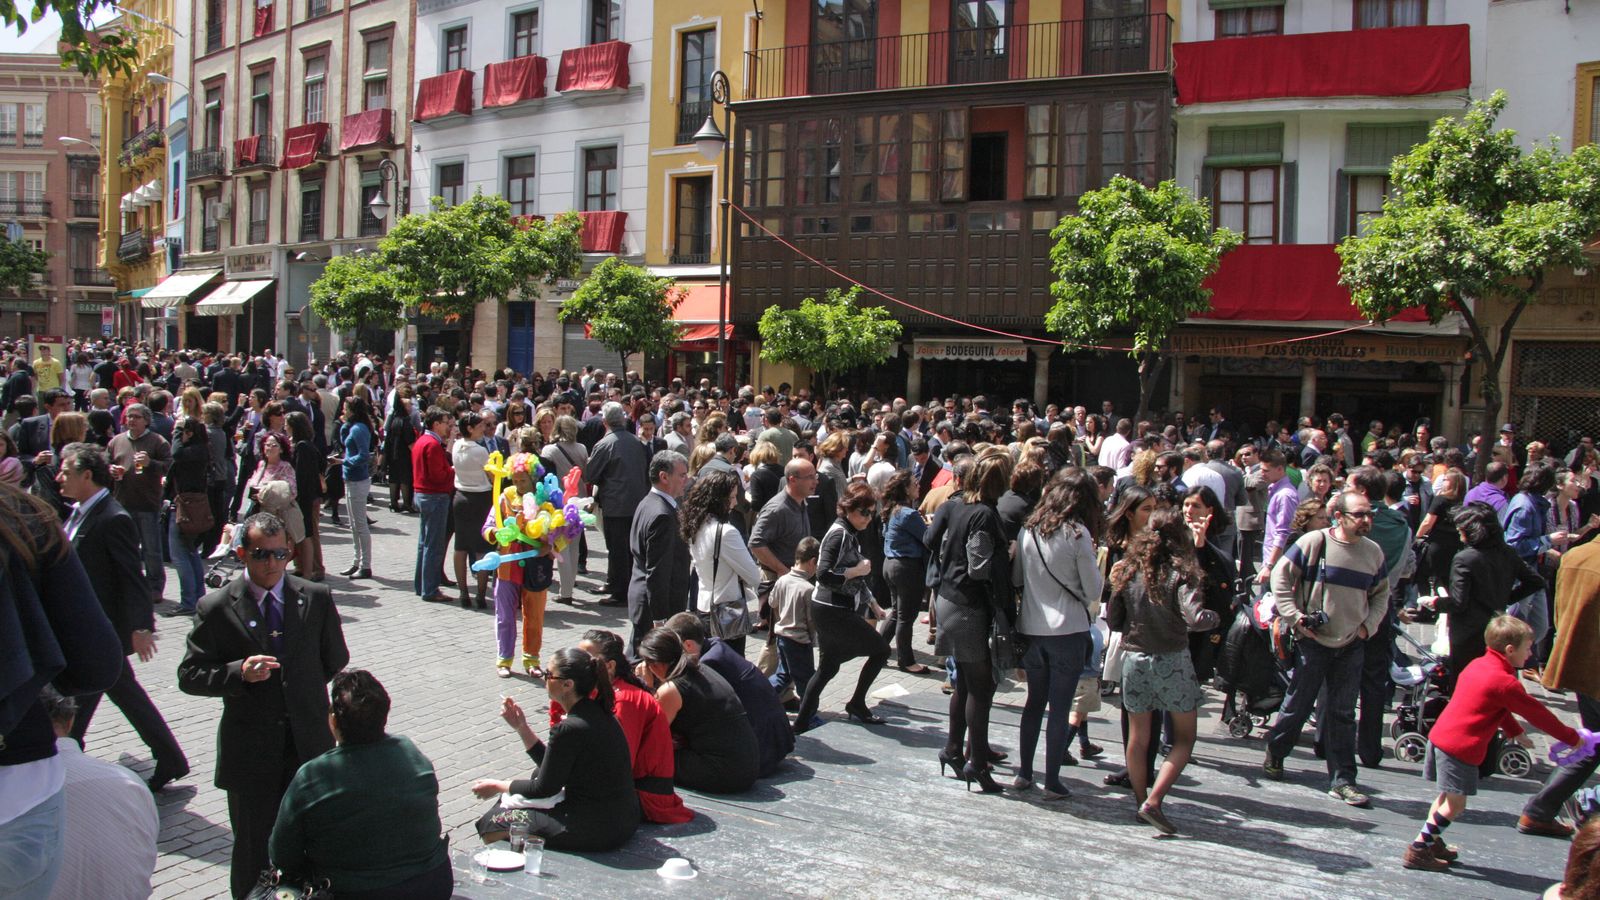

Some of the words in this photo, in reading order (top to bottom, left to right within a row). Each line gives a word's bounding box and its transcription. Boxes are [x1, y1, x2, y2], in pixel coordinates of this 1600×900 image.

[945, 345, 995, 357] BODEGUITA
[1172, 335, 1250, 355] MAESTRANTE
[1385, 344, 1457, 357] BARBADILLO
